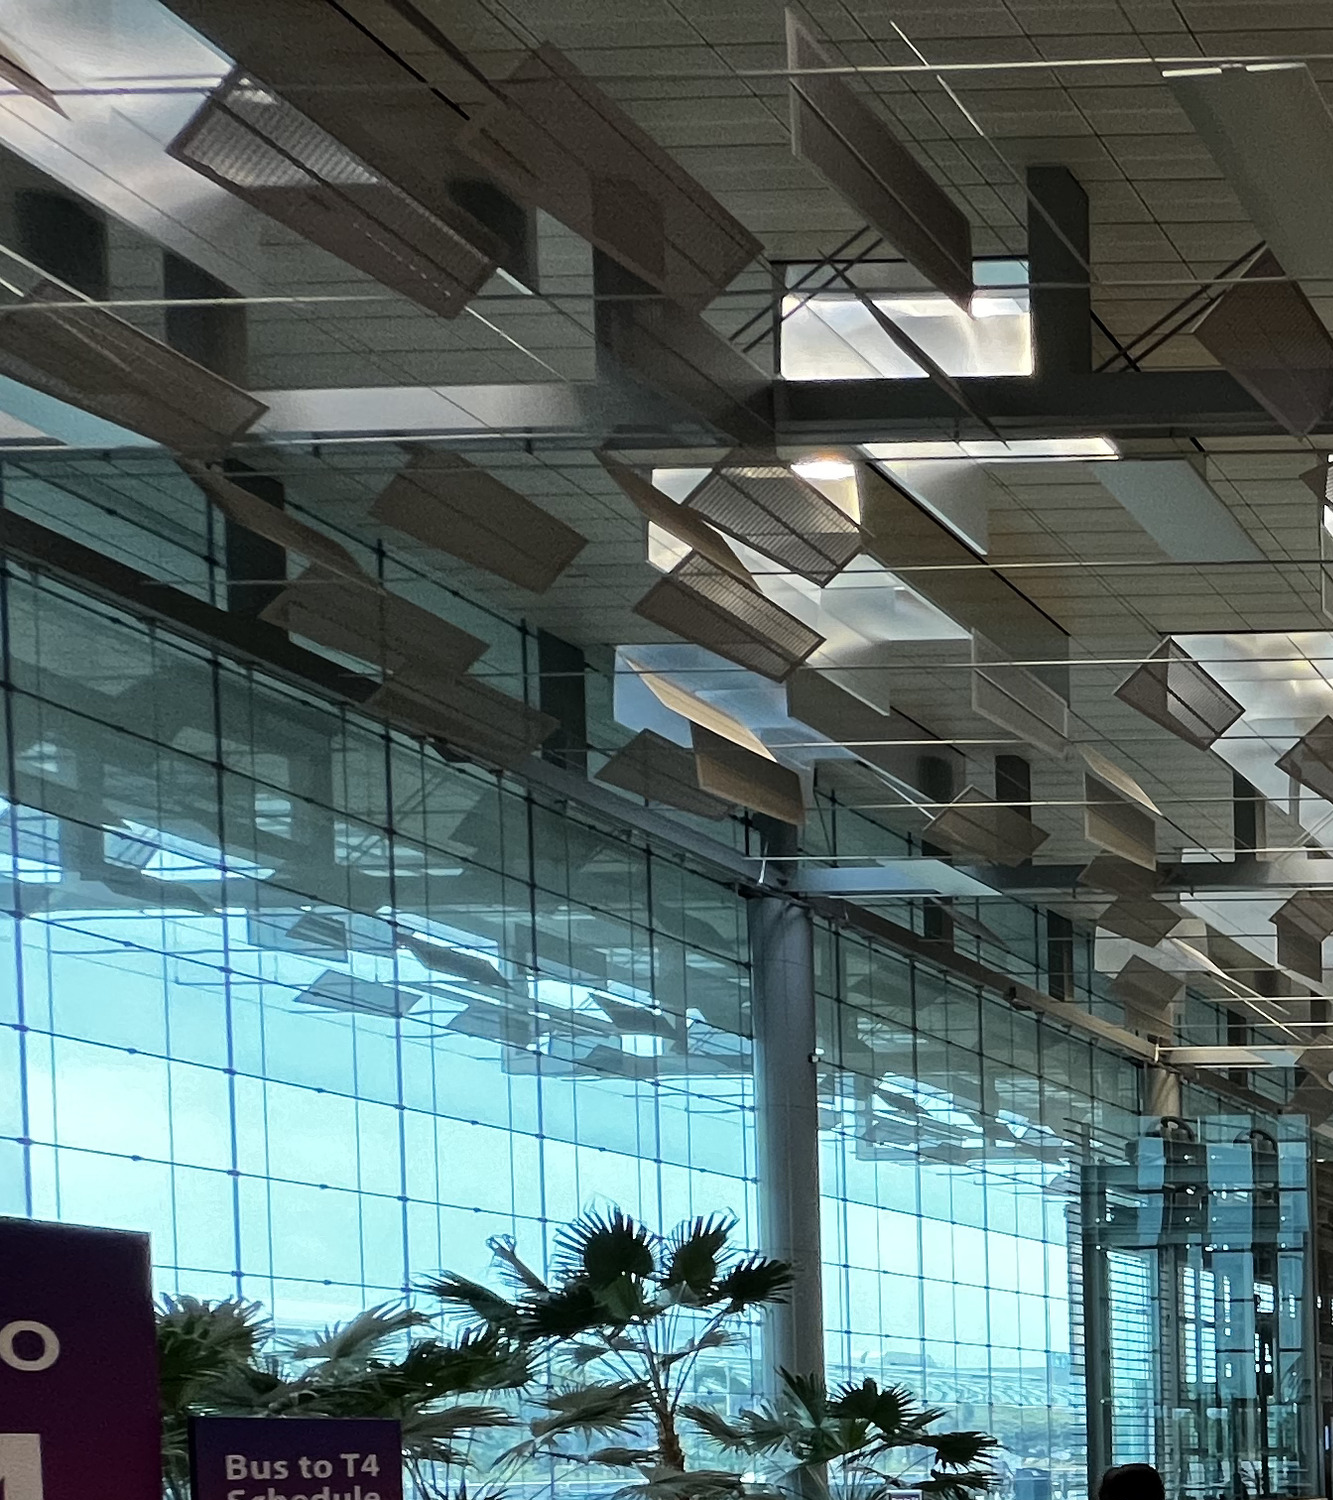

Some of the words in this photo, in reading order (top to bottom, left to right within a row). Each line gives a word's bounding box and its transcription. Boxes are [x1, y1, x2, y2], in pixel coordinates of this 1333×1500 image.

[225, 1454, 289, 1480] Bus
[298, 1456, 333, 1479] to
[340, 1453, 380, 1477] T4
